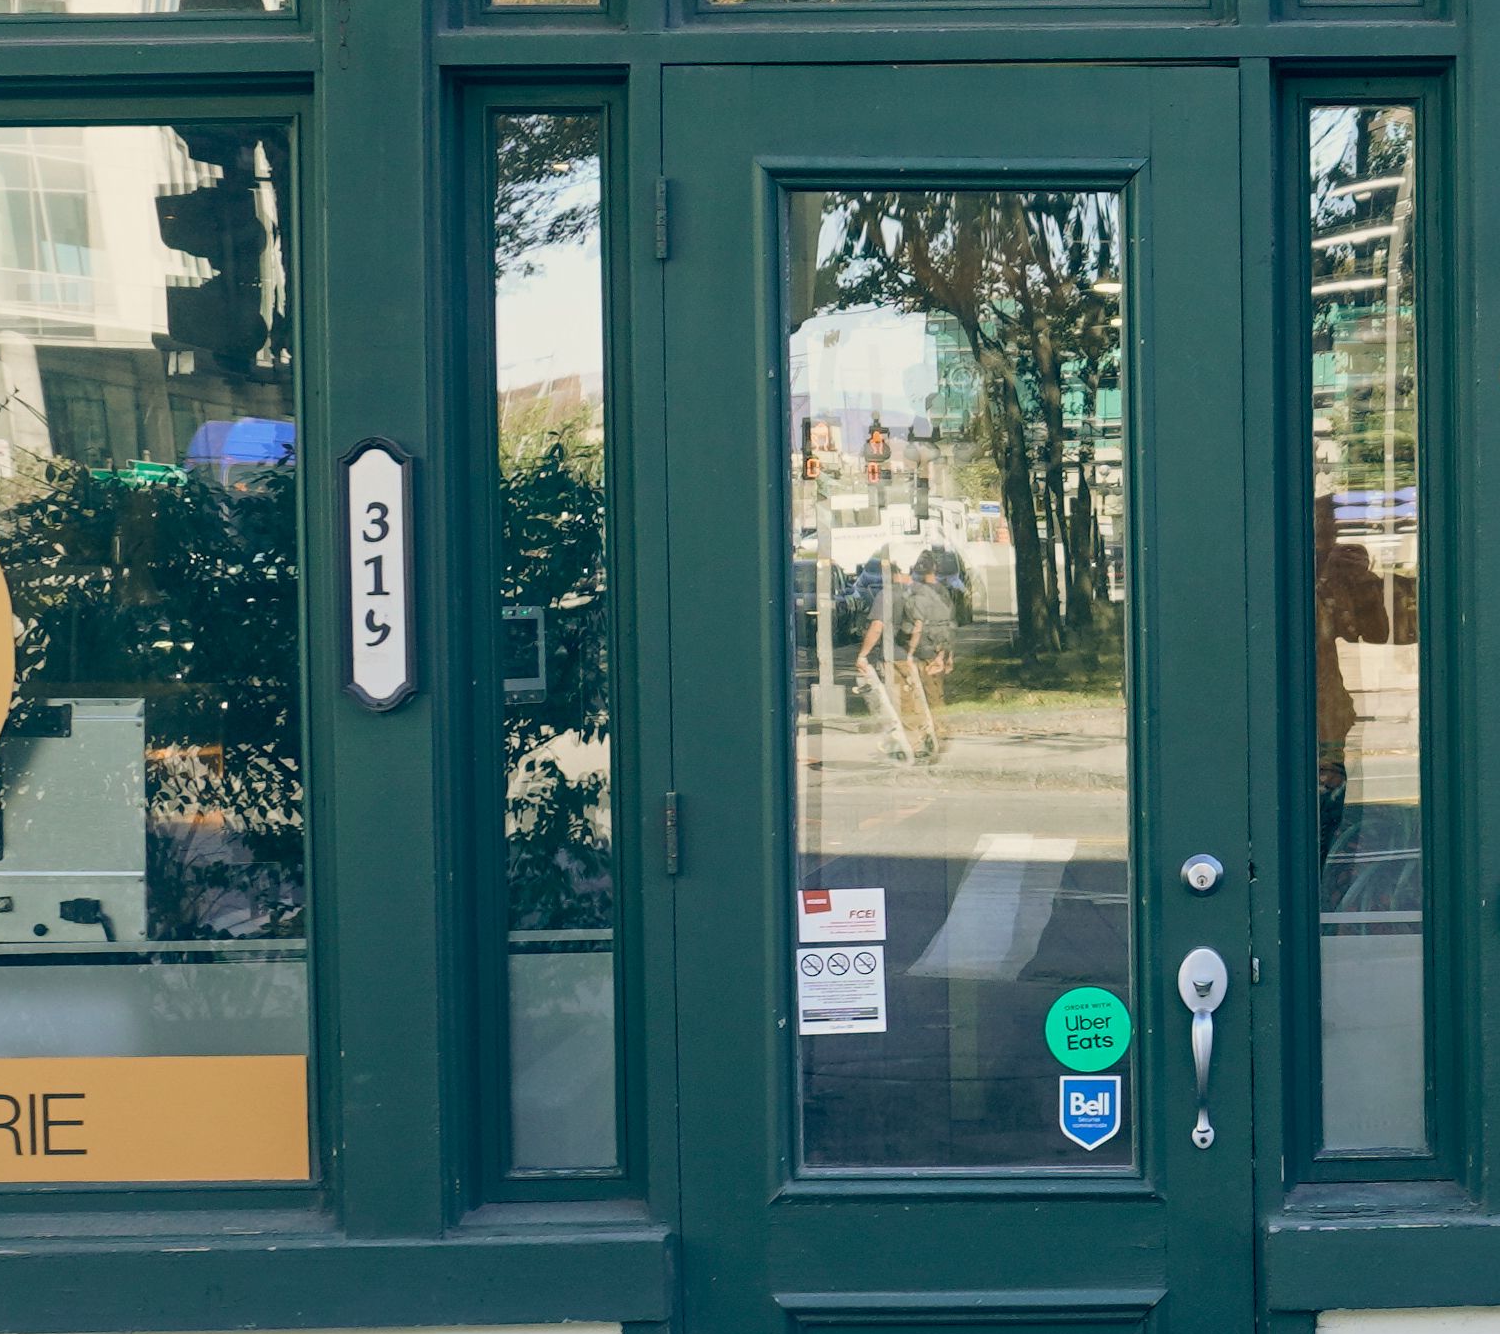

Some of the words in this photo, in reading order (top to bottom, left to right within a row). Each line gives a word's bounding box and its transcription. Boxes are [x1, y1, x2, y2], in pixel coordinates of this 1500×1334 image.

[848, 909, 876, 919] FCEI
[1065, 1014, 1112, 1031] Uber
[1067, 1034, 1114, 1050] Eats
[1070, 1092, 1110, 1116] Bell
